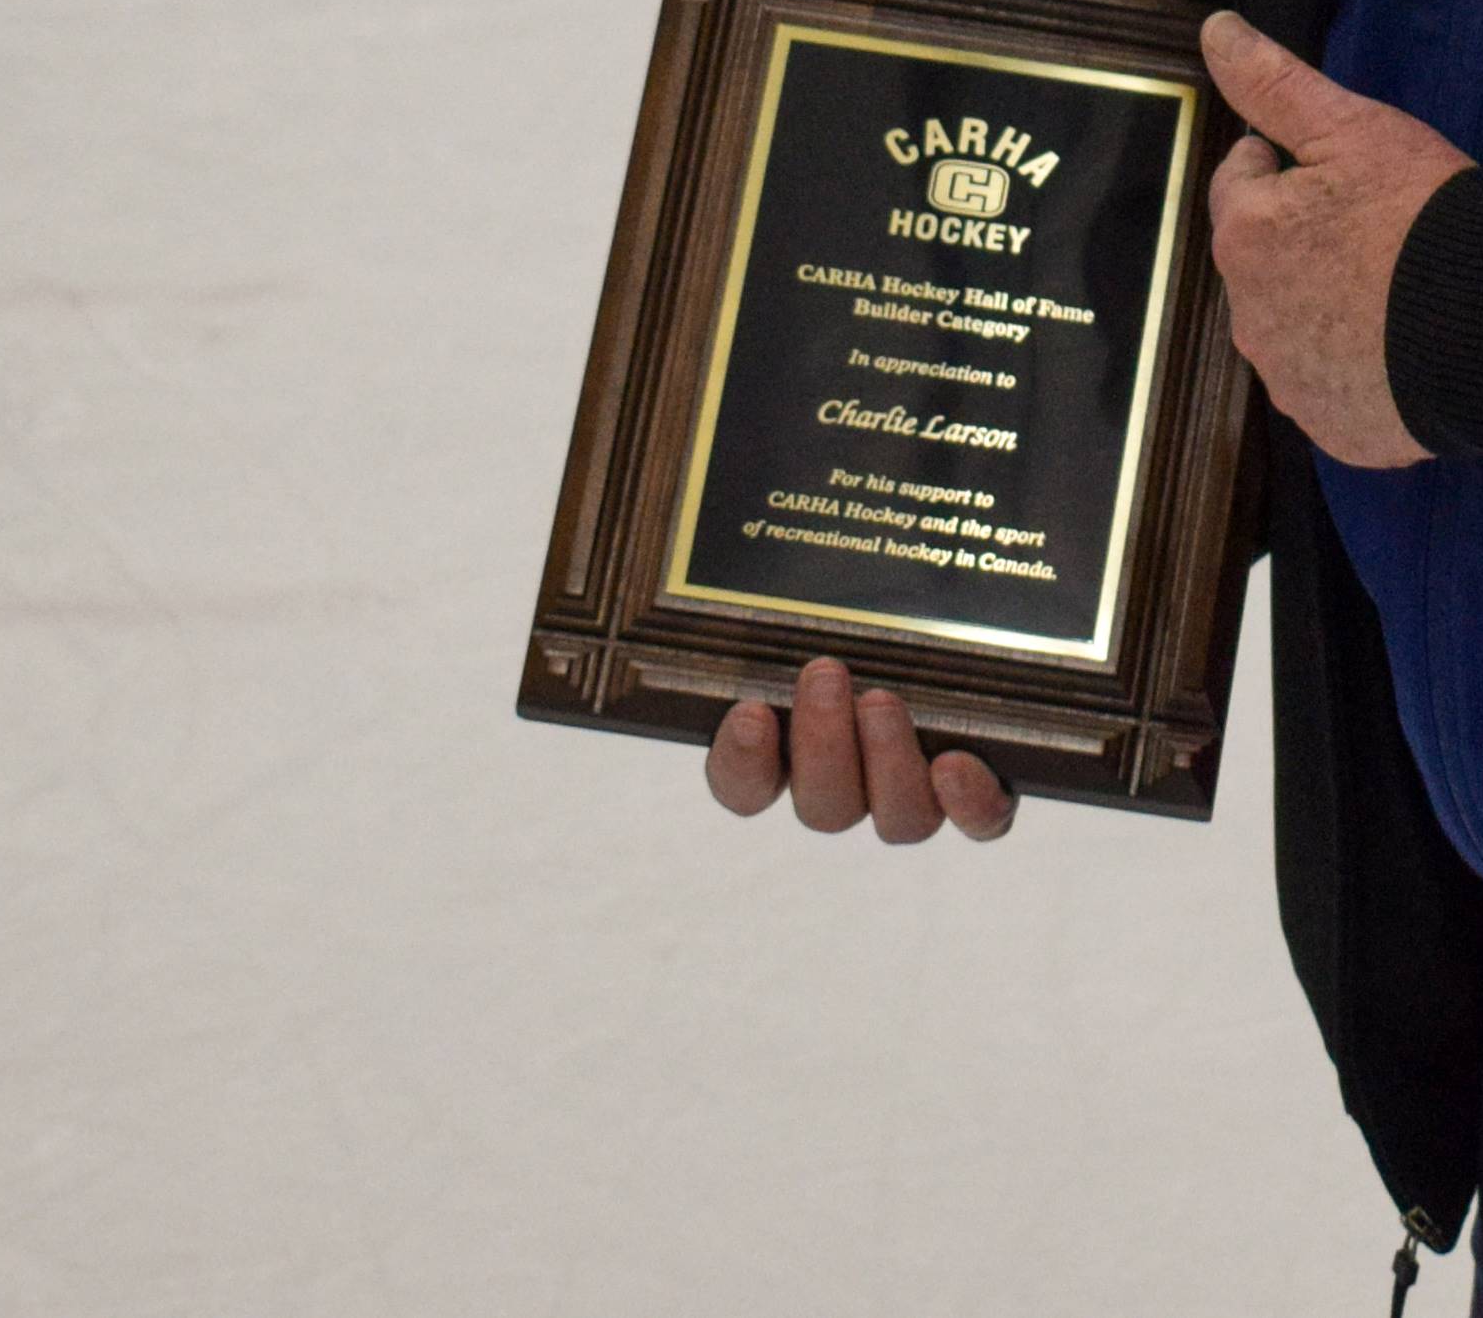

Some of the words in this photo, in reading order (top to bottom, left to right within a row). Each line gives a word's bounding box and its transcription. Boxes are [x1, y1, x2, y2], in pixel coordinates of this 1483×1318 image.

[884, 117, 1060, 188] CARHA
[888, 208, 1031, 254] HOCKEY
[797, 264, 877, 290] CARHA
[882, 275, 960, 305] Hockey
[964, 287, 1008, 311] Hall
[1012, 296, 1037, 315] of
[1038, 298, 1095, 324] Fame
[853, 298, 933, 325] Builder
[937, 310, 1030, 343] Category
[848, 349, 870, 366] In
[873, 355, 992, 386] appreciation
[996, 370, 1016, 389] to
[817, 399, 918, 435] Charlie
[920, 415, 1017, 451] Larson
[829, 468, 863, 487] For
[867, 473, 894, 494] his
[898, 482, 971, 506] support
[974, 490, 994, 509] to
[768, 491, 840, 516] CARHA
[845, 501, 917, 530] Hockey
[921, 515, 957, 534] and
[961, 519, 991, 540] the
[994, 527, 1046, 548] sport
[742, 520, 765, 539] of
[767, 524, 881, 553] recreational
[885, 538, 953, 566] hockey
[955, 549, 975, 567] in
[979, 553, 1057, 581] Canada.
